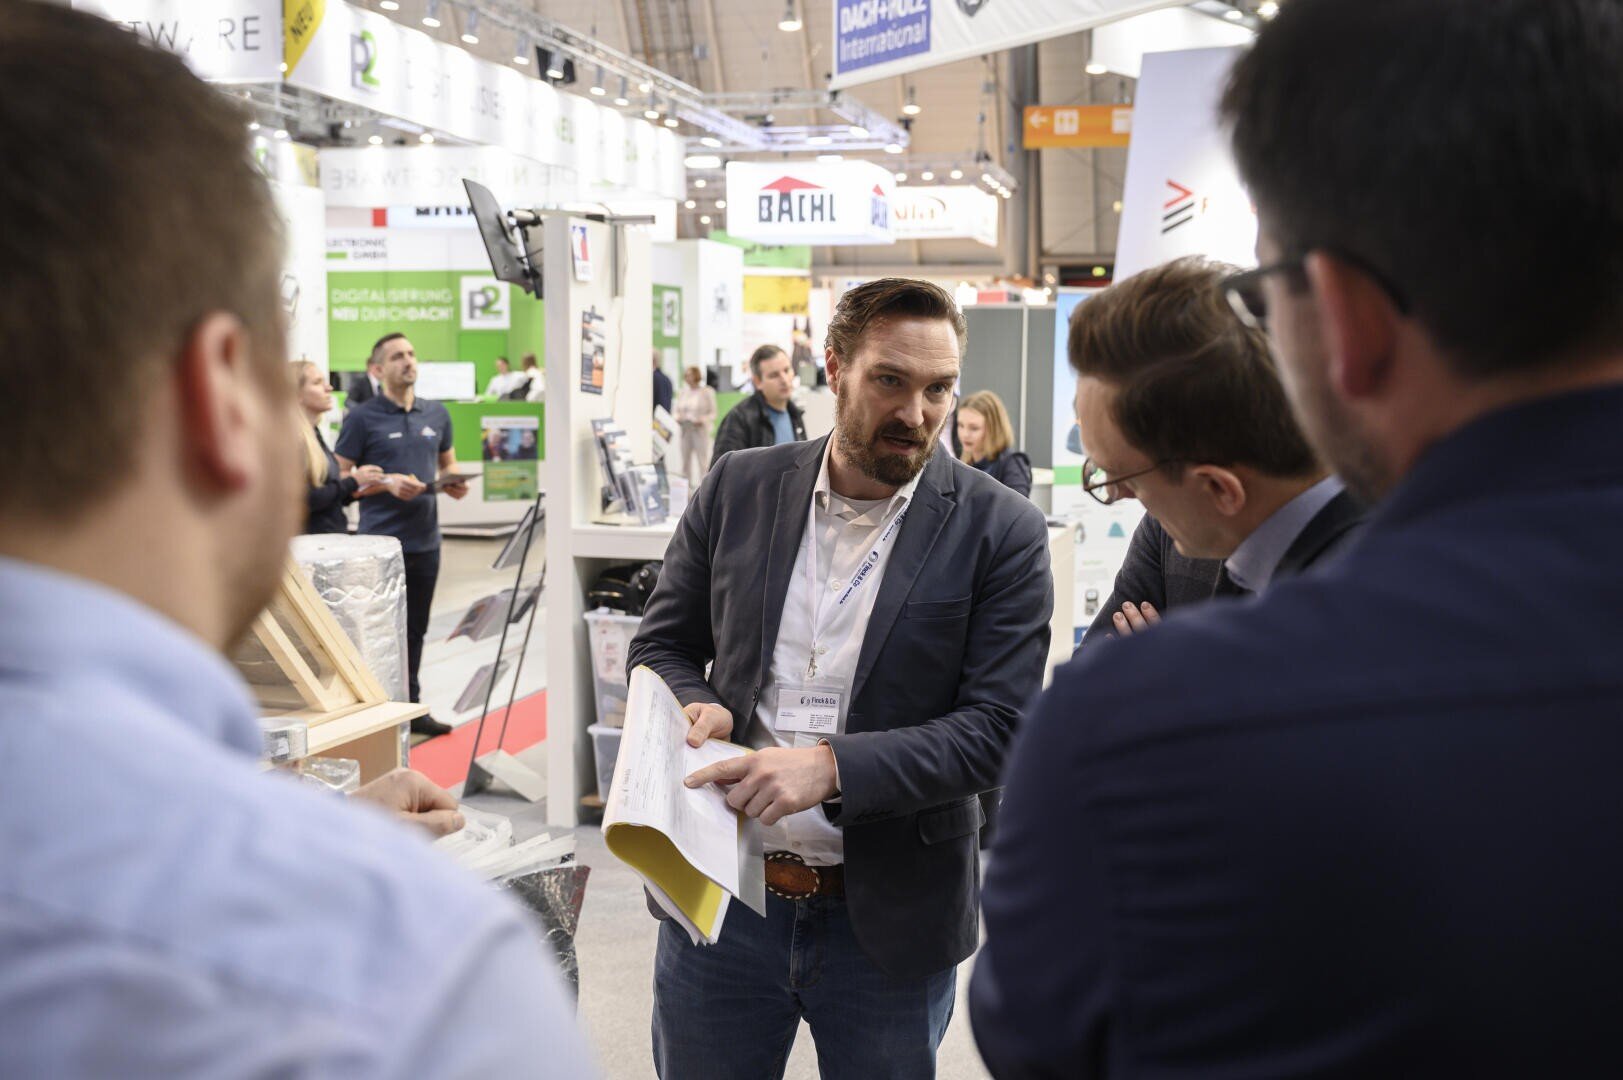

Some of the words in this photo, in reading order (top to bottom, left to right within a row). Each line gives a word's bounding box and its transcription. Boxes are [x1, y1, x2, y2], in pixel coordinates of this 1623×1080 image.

[839, 15, 927, 63] International
[758, 194, 836, 223] BACHL
[326, 238, 387, 249] LECTRONIC
[331, 288, 453, 304] DIGITALISIERUNG
[360, 306, 453, 321] DURCHDACHT
